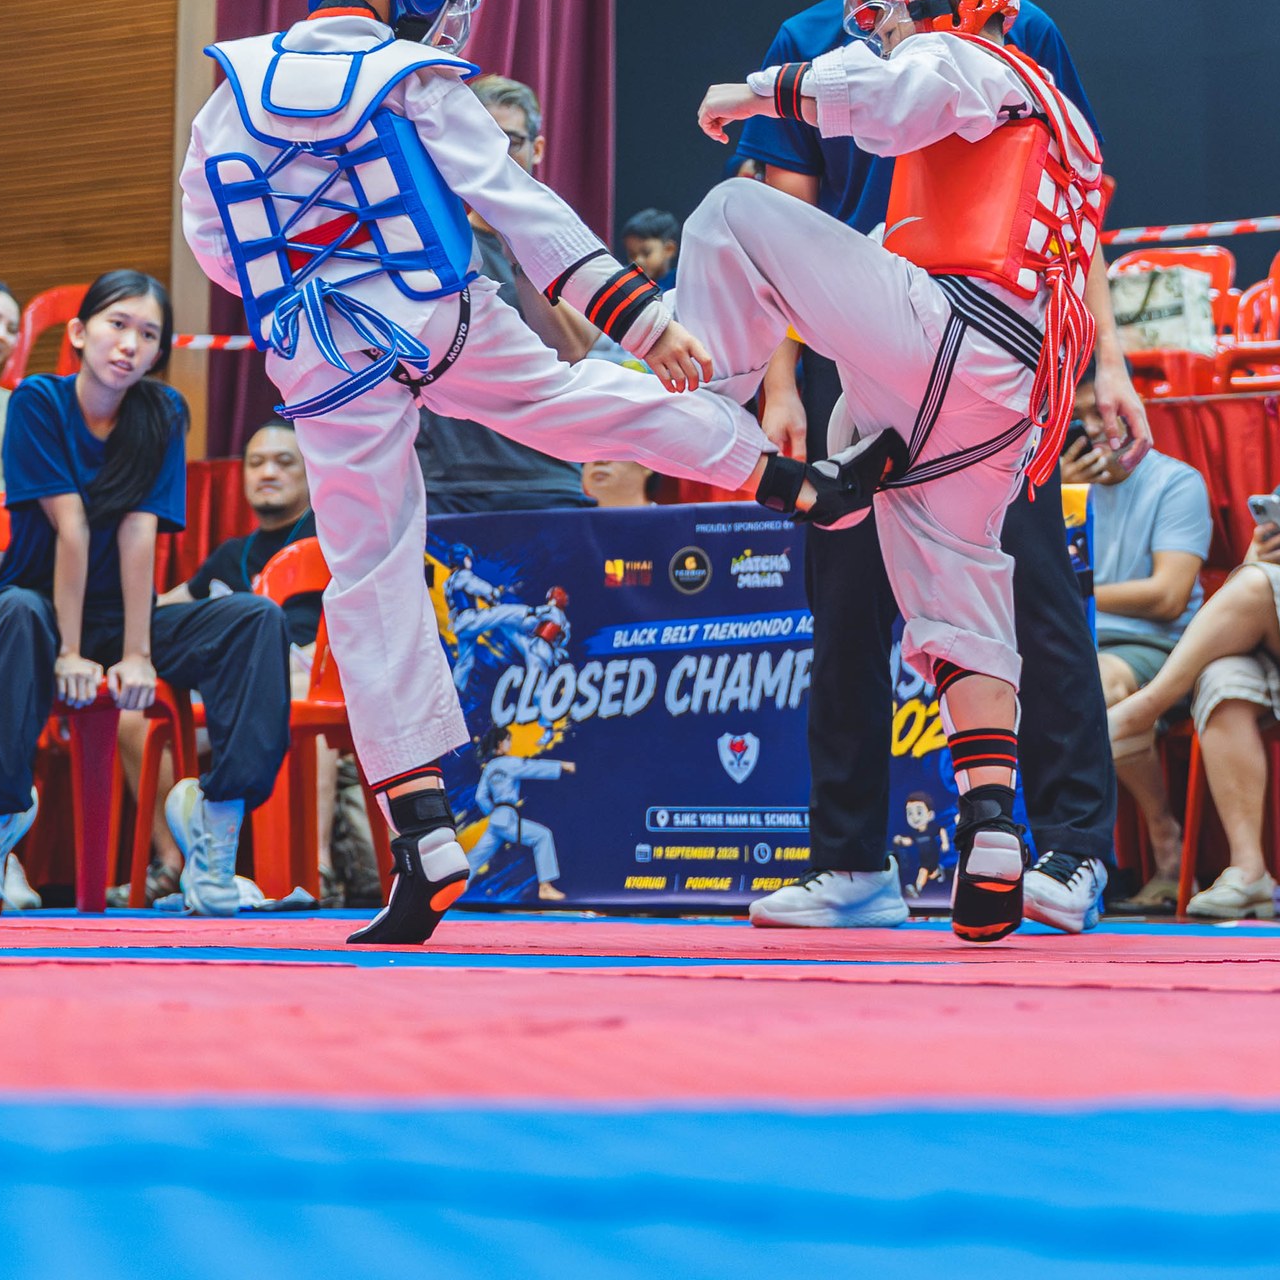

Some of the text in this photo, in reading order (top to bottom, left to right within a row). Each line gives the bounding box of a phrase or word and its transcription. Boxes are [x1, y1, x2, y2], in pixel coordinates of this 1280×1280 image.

[446, 322, 468, 363] MOOTO
[734, 521, 781, 532] SPONSORED
[613, 628, 658, 649] BLACK
[661, 624, 699, 645] BELT
[702, 616, 793, 641] TAEKWONDO
[491, 657, 658, 728] CLOSED
[699, 813, 723, 827] YOKE
[725, 813, 748, 827] NAM
[749, 813, 763, 827] KL
[764, 813, 802, 827] SCHOOL
[664, 847, 716, 860] SEPTEMBER
[685, 876, 733, 891] POOMSAE
[751, 877, 782, 891] SPEED
